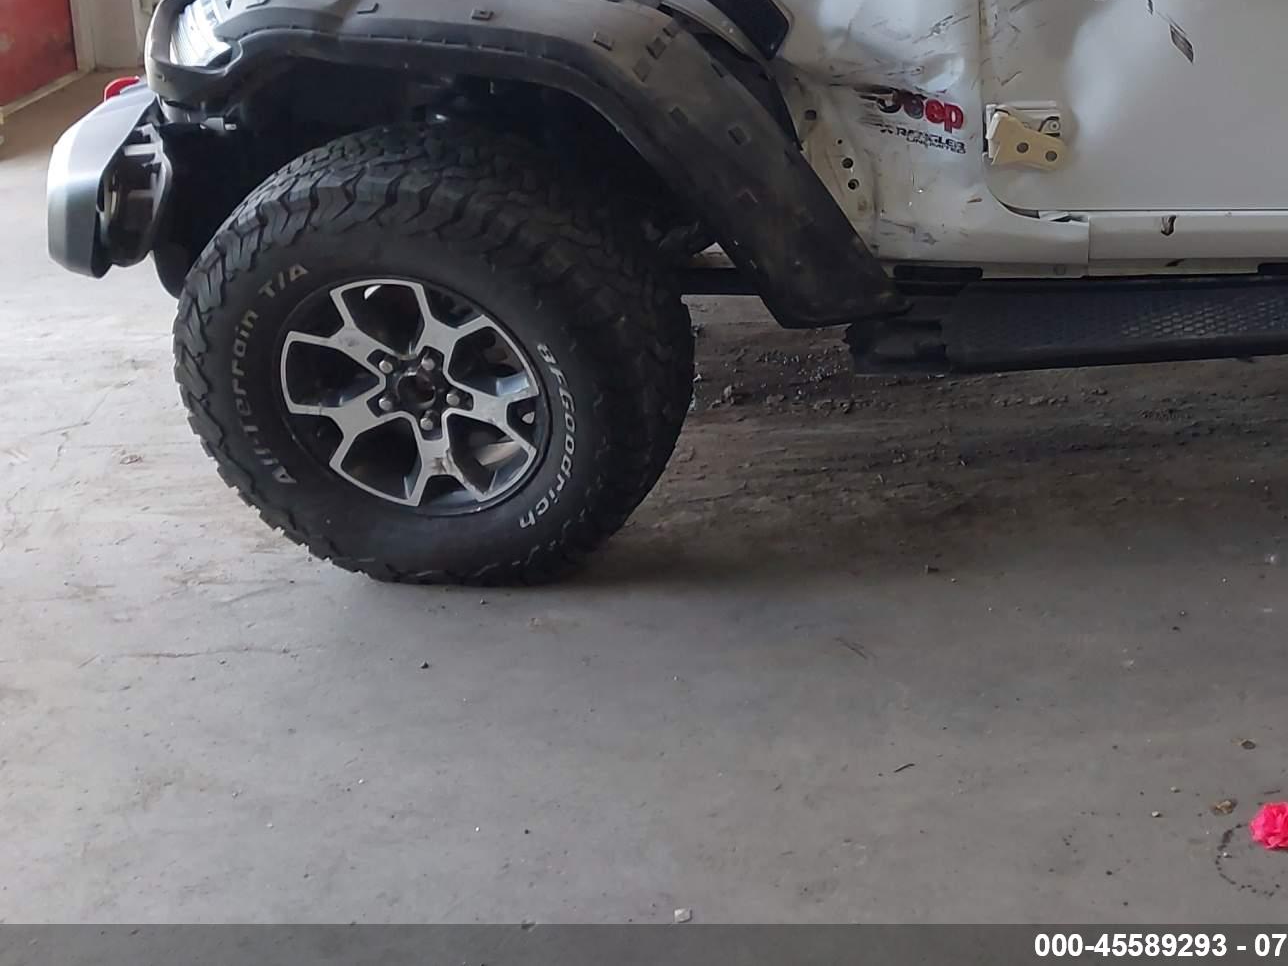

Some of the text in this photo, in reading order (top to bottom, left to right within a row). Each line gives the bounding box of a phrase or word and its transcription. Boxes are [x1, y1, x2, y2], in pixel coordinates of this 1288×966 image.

[232, 263, 309, 484] All-Terrain T/A
[519, 343, 577, 529] BFGoodrich
